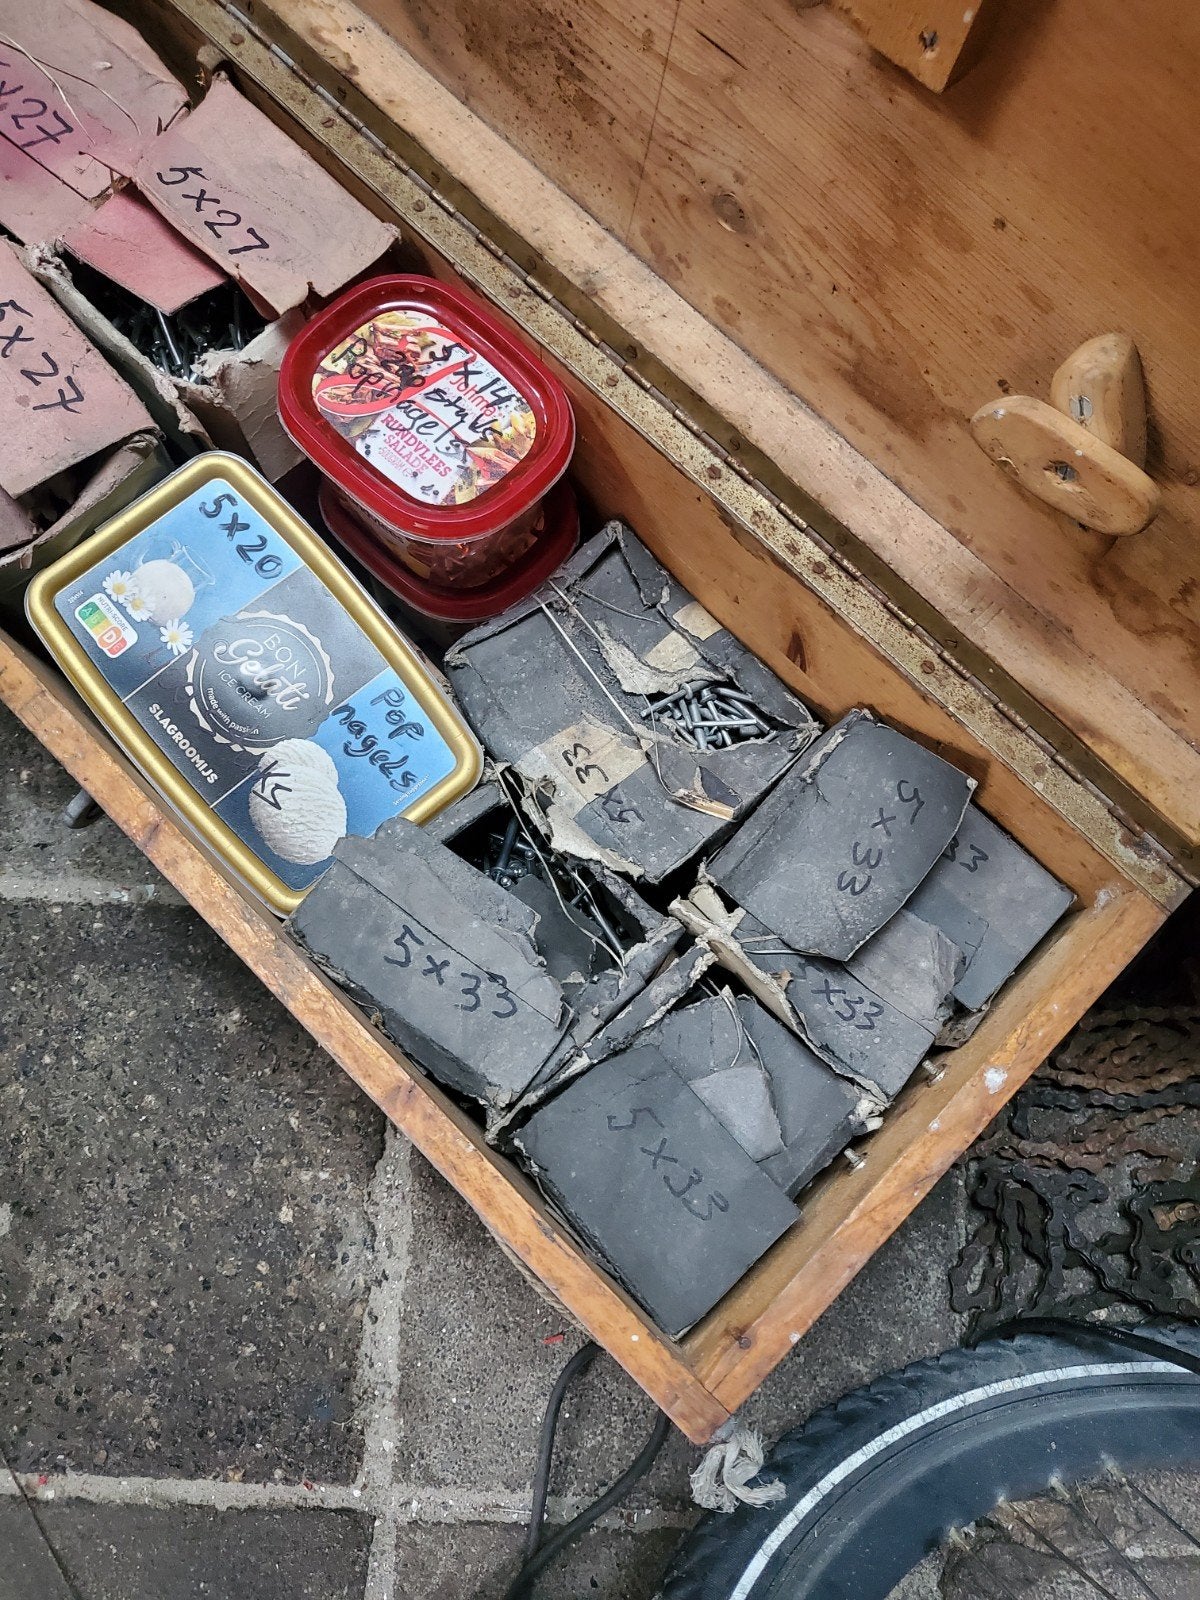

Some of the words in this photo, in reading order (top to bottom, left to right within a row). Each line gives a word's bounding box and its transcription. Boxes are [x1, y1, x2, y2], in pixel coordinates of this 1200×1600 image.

[156, 167, 270, 255] 5x27
[449, 376, 496, 417] Johma
[380, 413, 452, 477] RUNDVLEES
[384, 434, 429, 474] SALADE
[198, 493, 283, 579] 5x20
[97, 596, 129, 632] NUTRI-SCORE
[102, 629, 117, 643] D
[214, 639, 310, 711] Gelati
[263, 633, 306, 680] BON
[207, 687, 219, 709] made
[216, 708, 231, 725] with
[218, 669, 238, 688] ICE
[235, 686, 272, 719] CREAM
[148, 703, 219, 784] SLAGROOMIJS
[837, 779, 925, 896] 5x33
[383, 924, 518, 1019] 5x33
[606, 1106, 729, 1220] 5x33
